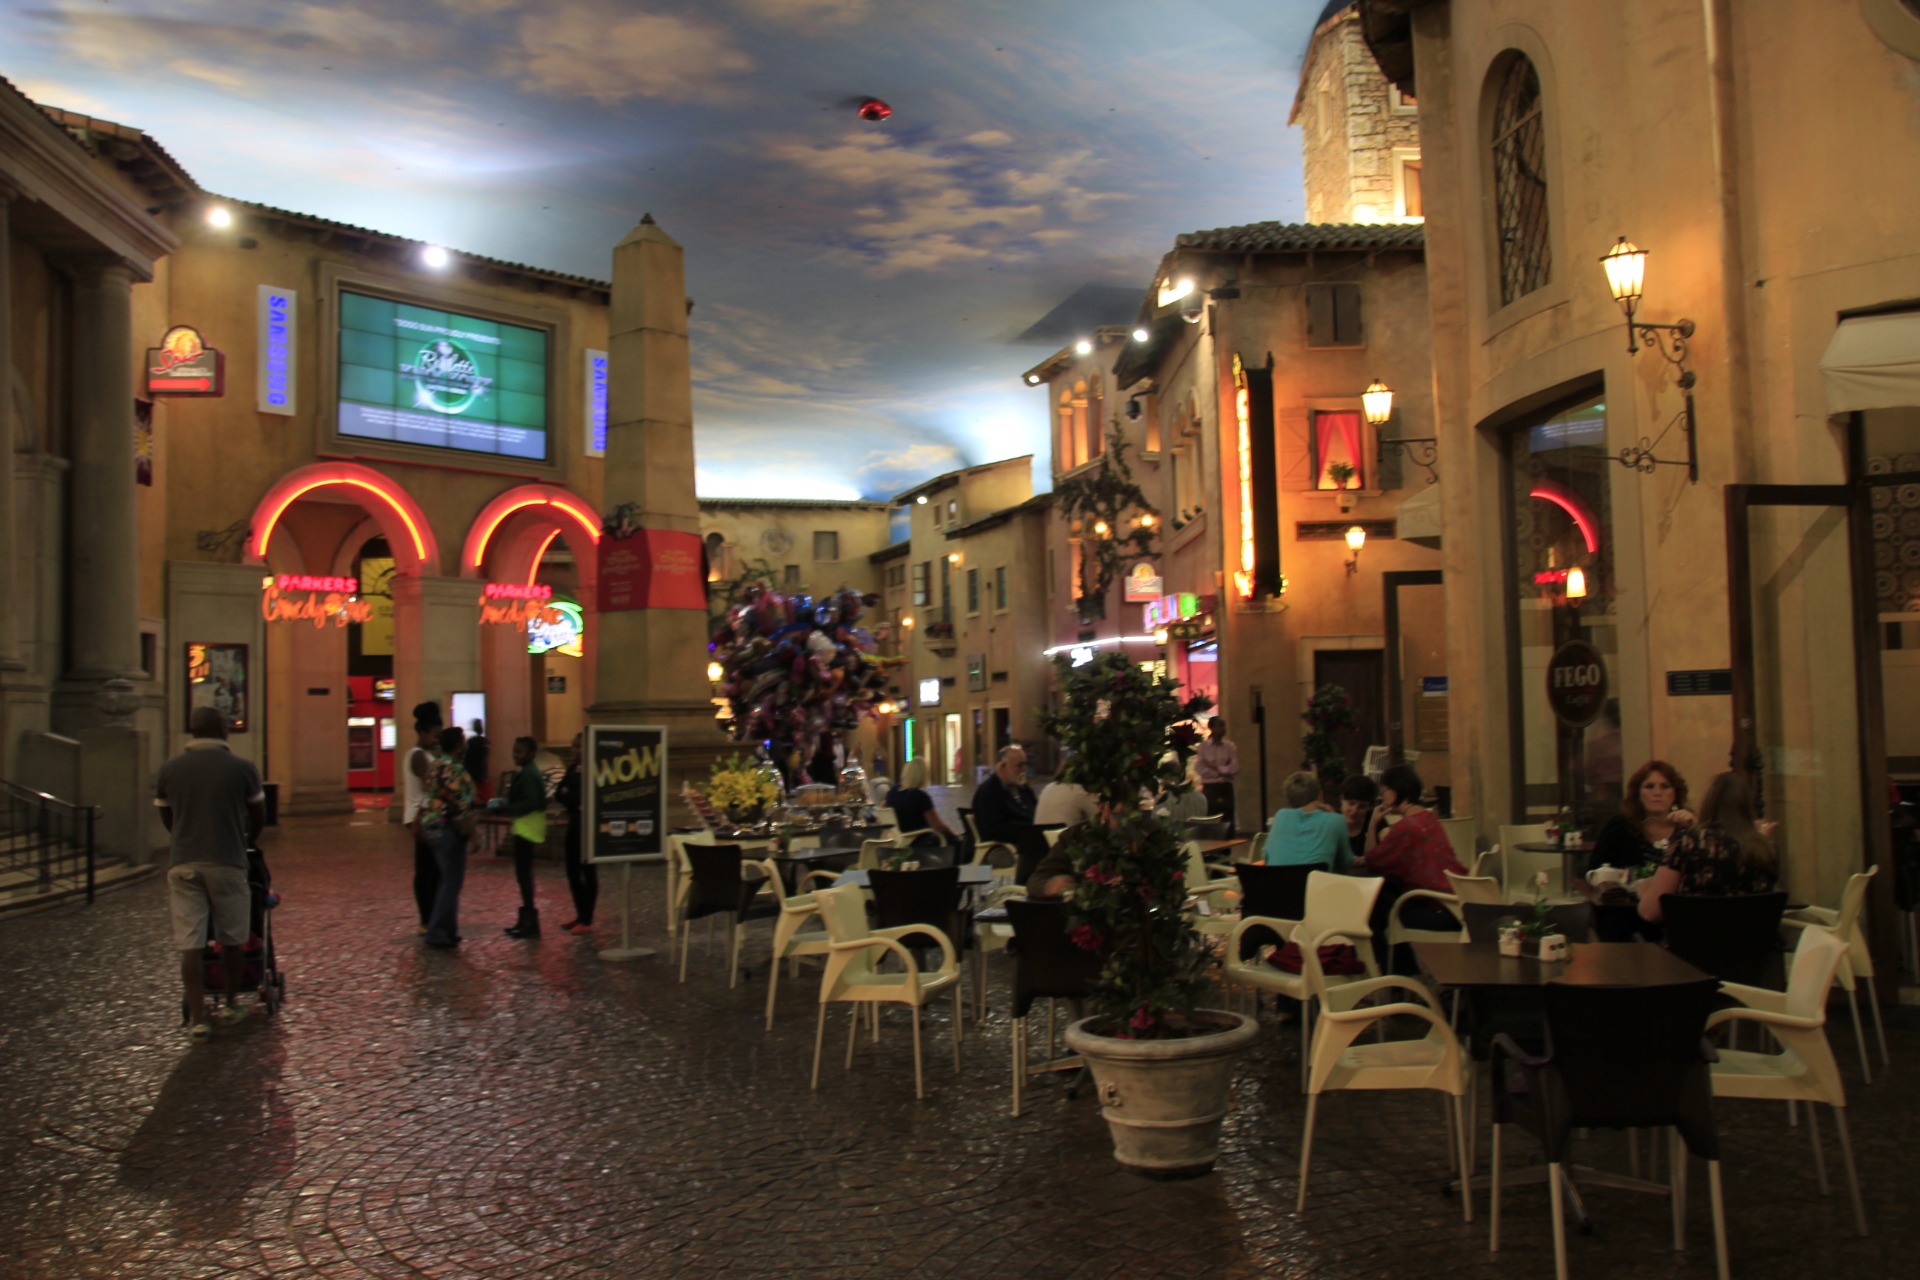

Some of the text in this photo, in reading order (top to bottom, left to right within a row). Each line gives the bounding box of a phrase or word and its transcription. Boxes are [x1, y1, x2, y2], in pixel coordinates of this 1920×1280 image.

[268, 295, 288, 405] SAMSUNG
[592, 357, 608, 451] SAMSUNG
[277, 573, 359, 592] PARKERS
[485, 583, 553, 600] PARKERS
[1553, 664, 1601, 688] FEGO
[594, 743, 662, 788] WOW
